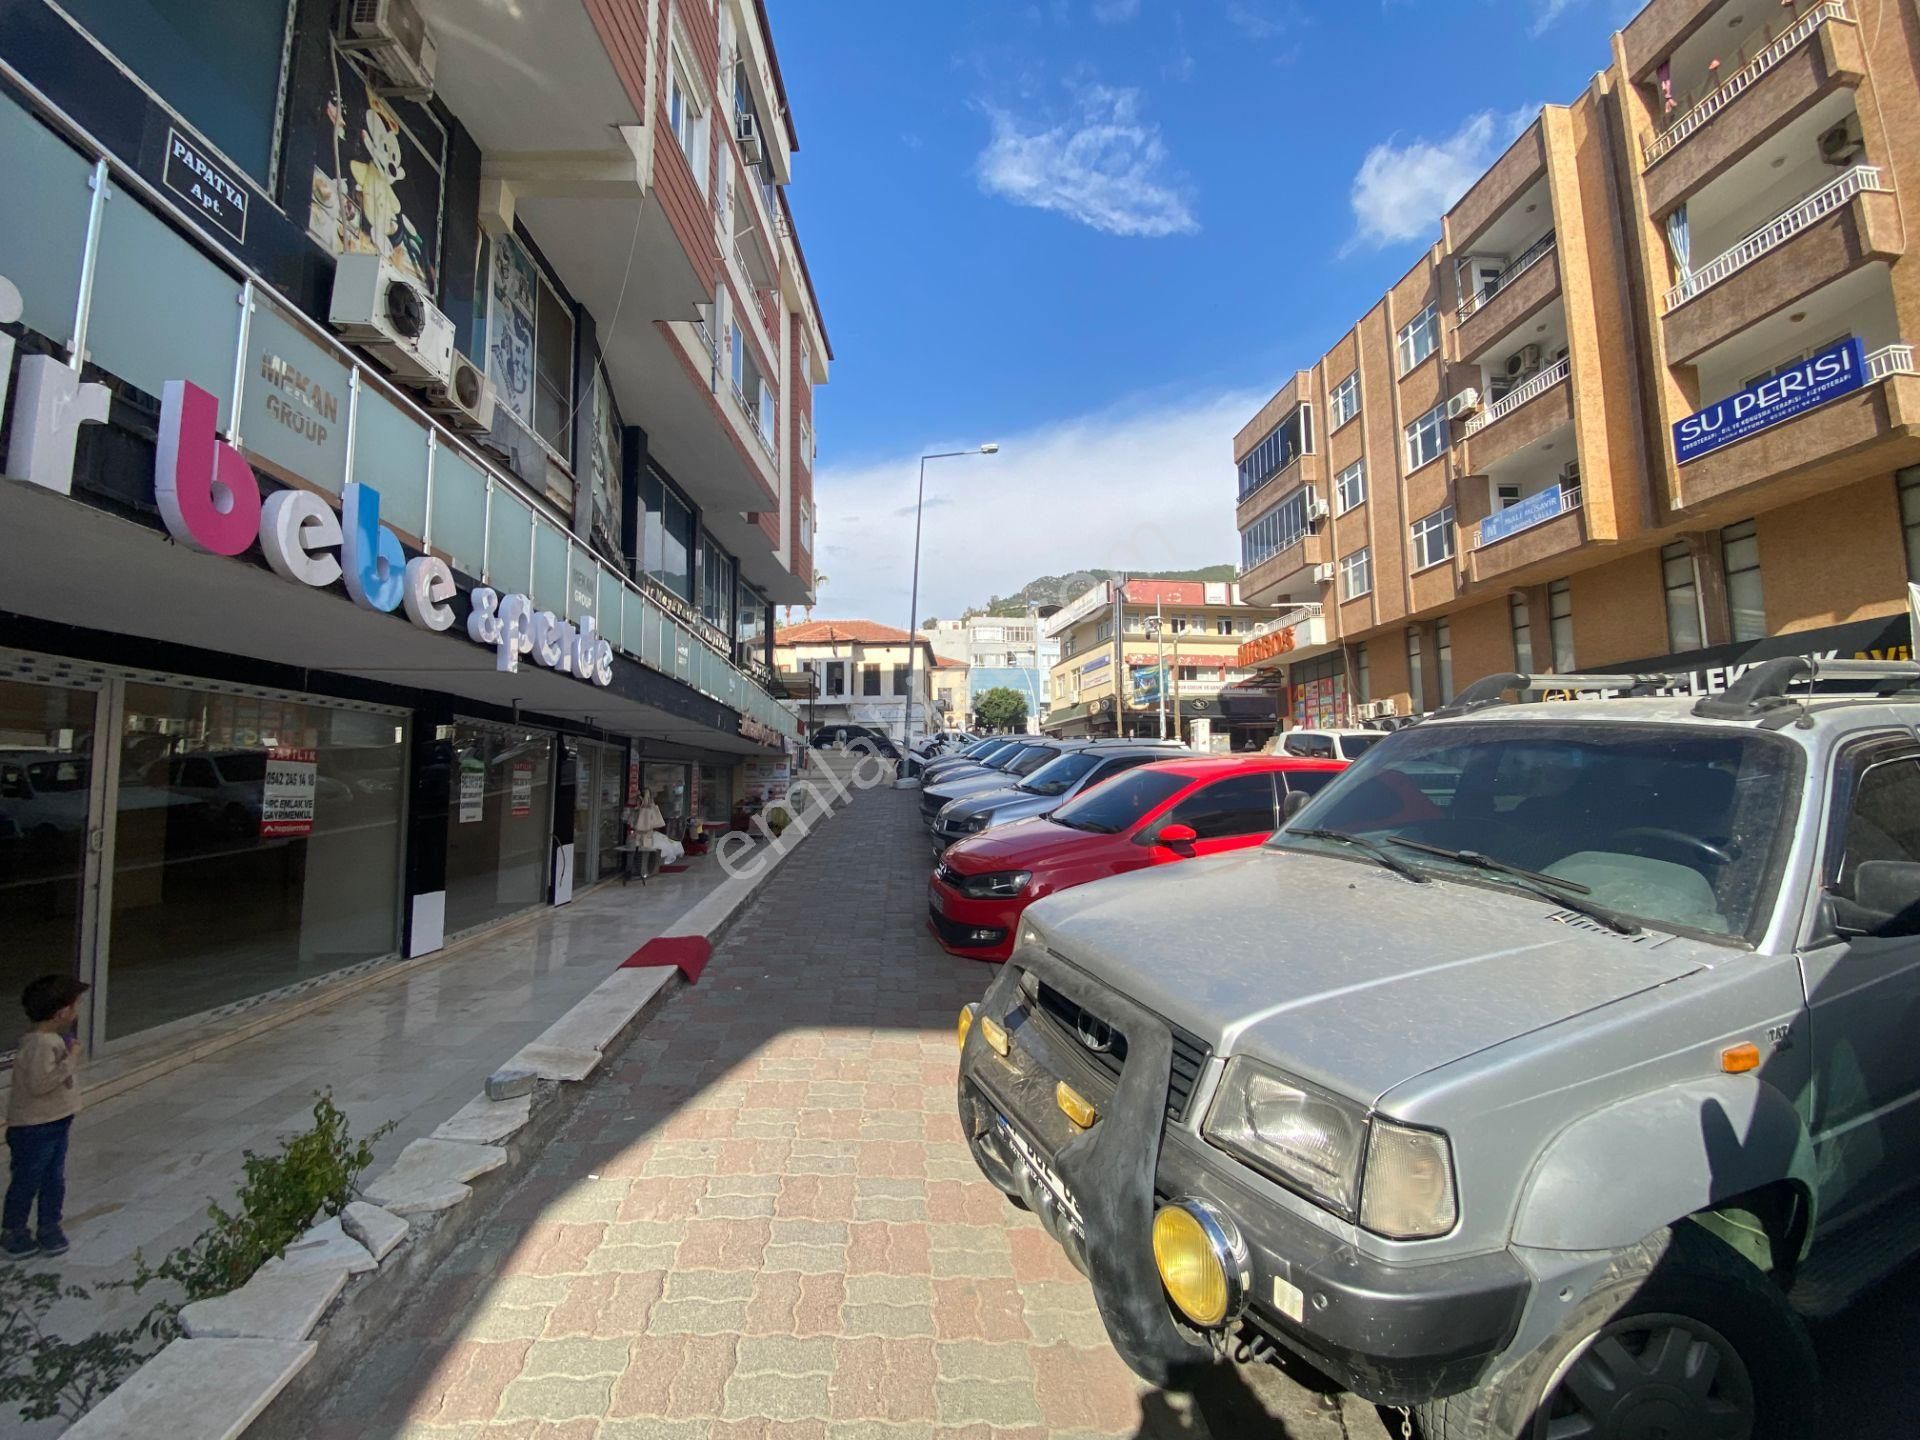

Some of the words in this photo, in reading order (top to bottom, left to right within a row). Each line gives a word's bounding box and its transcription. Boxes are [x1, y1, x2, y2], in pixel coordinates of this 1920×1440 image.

[173, 139, 244, 211] PAPATYA
[190, 183, 223, 217] Apt.
[261, 354, 338, 424] MEKAN
[266, 394, 328, 446] GROUP
[1681, 406, 1723, 441] SU
[1733, 347, 1850, 419] PERİSİ
[155, 380, 457, 632] bebe
